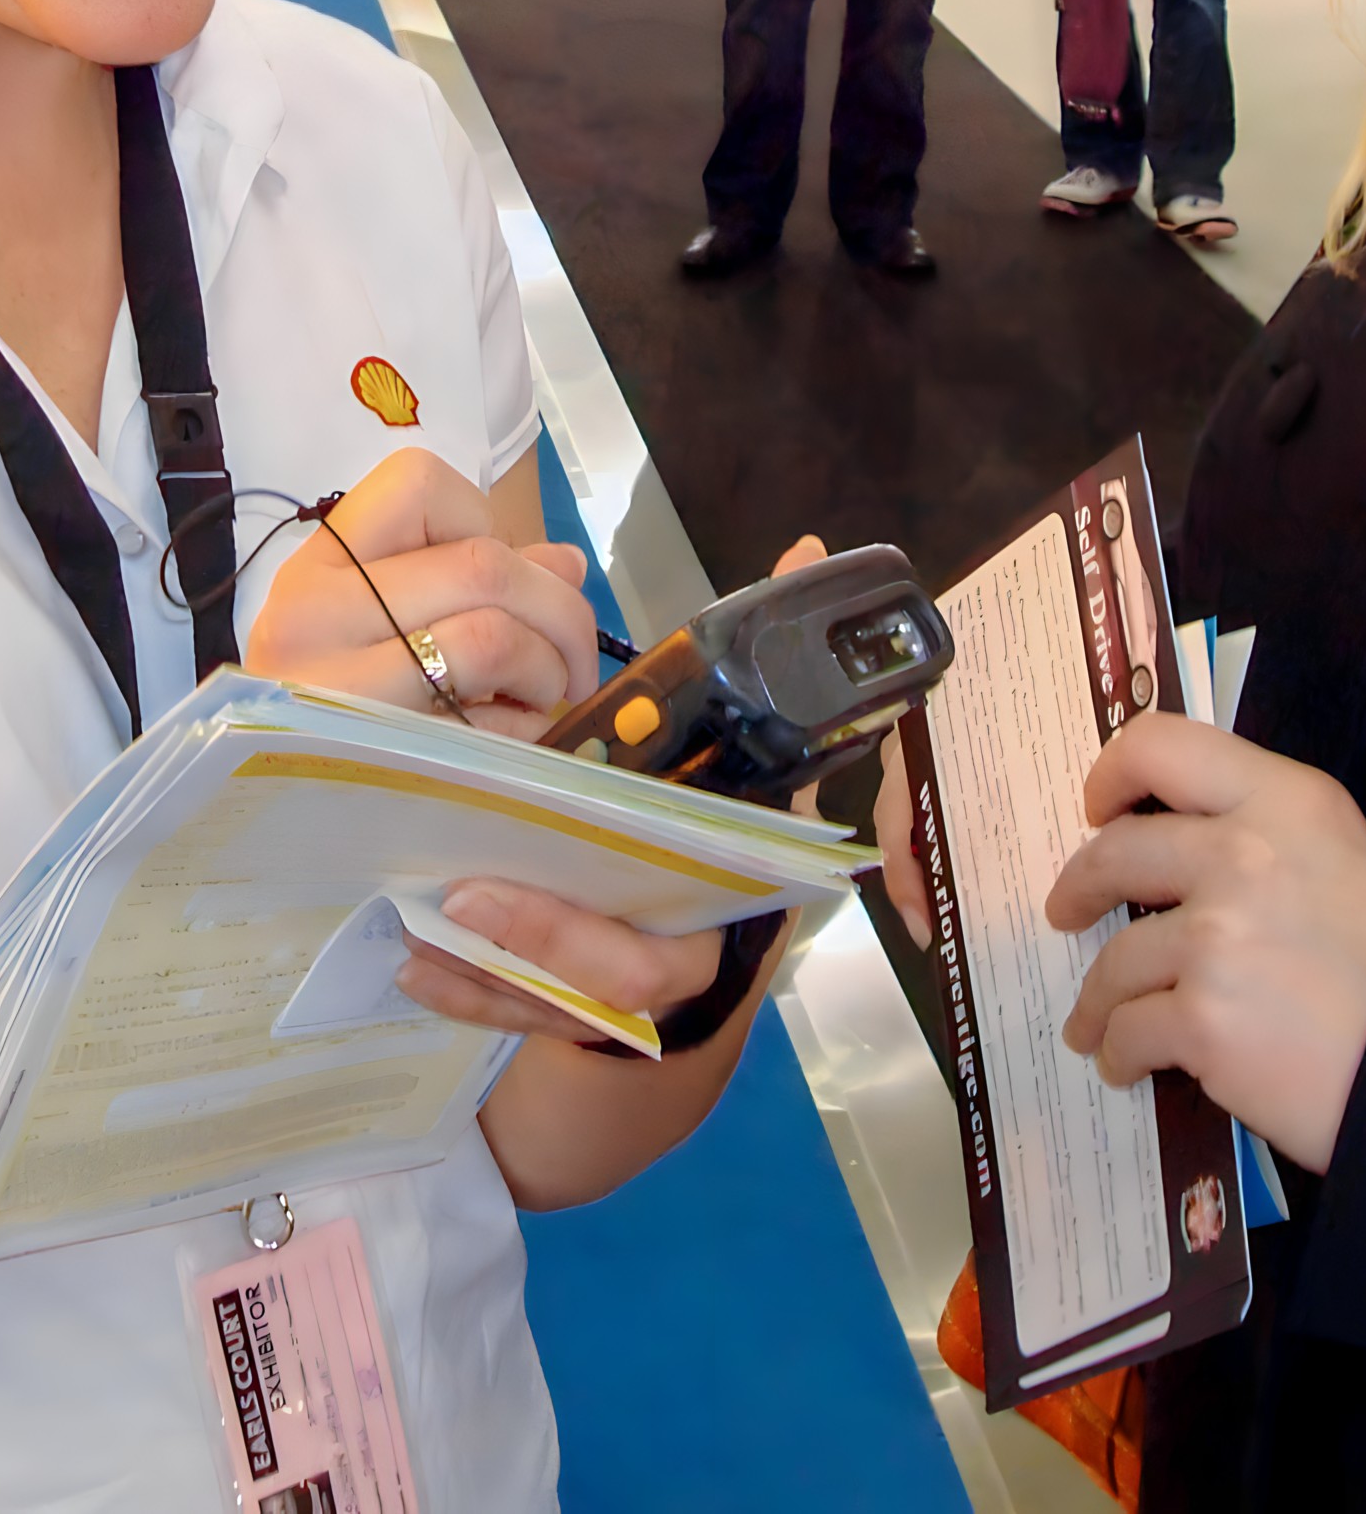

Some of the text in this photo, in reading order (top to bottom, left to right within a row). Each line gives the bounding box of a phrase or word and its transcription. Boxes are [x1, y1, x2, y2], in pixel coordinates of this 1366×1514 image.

[1074, 505, 1100, 576] Self
[1088, 587, 1115, 697] Drive
[219, 1301, 272, 1473] EARLS COURT
[245, 1282, 287, 1413] EXHIBITOR
